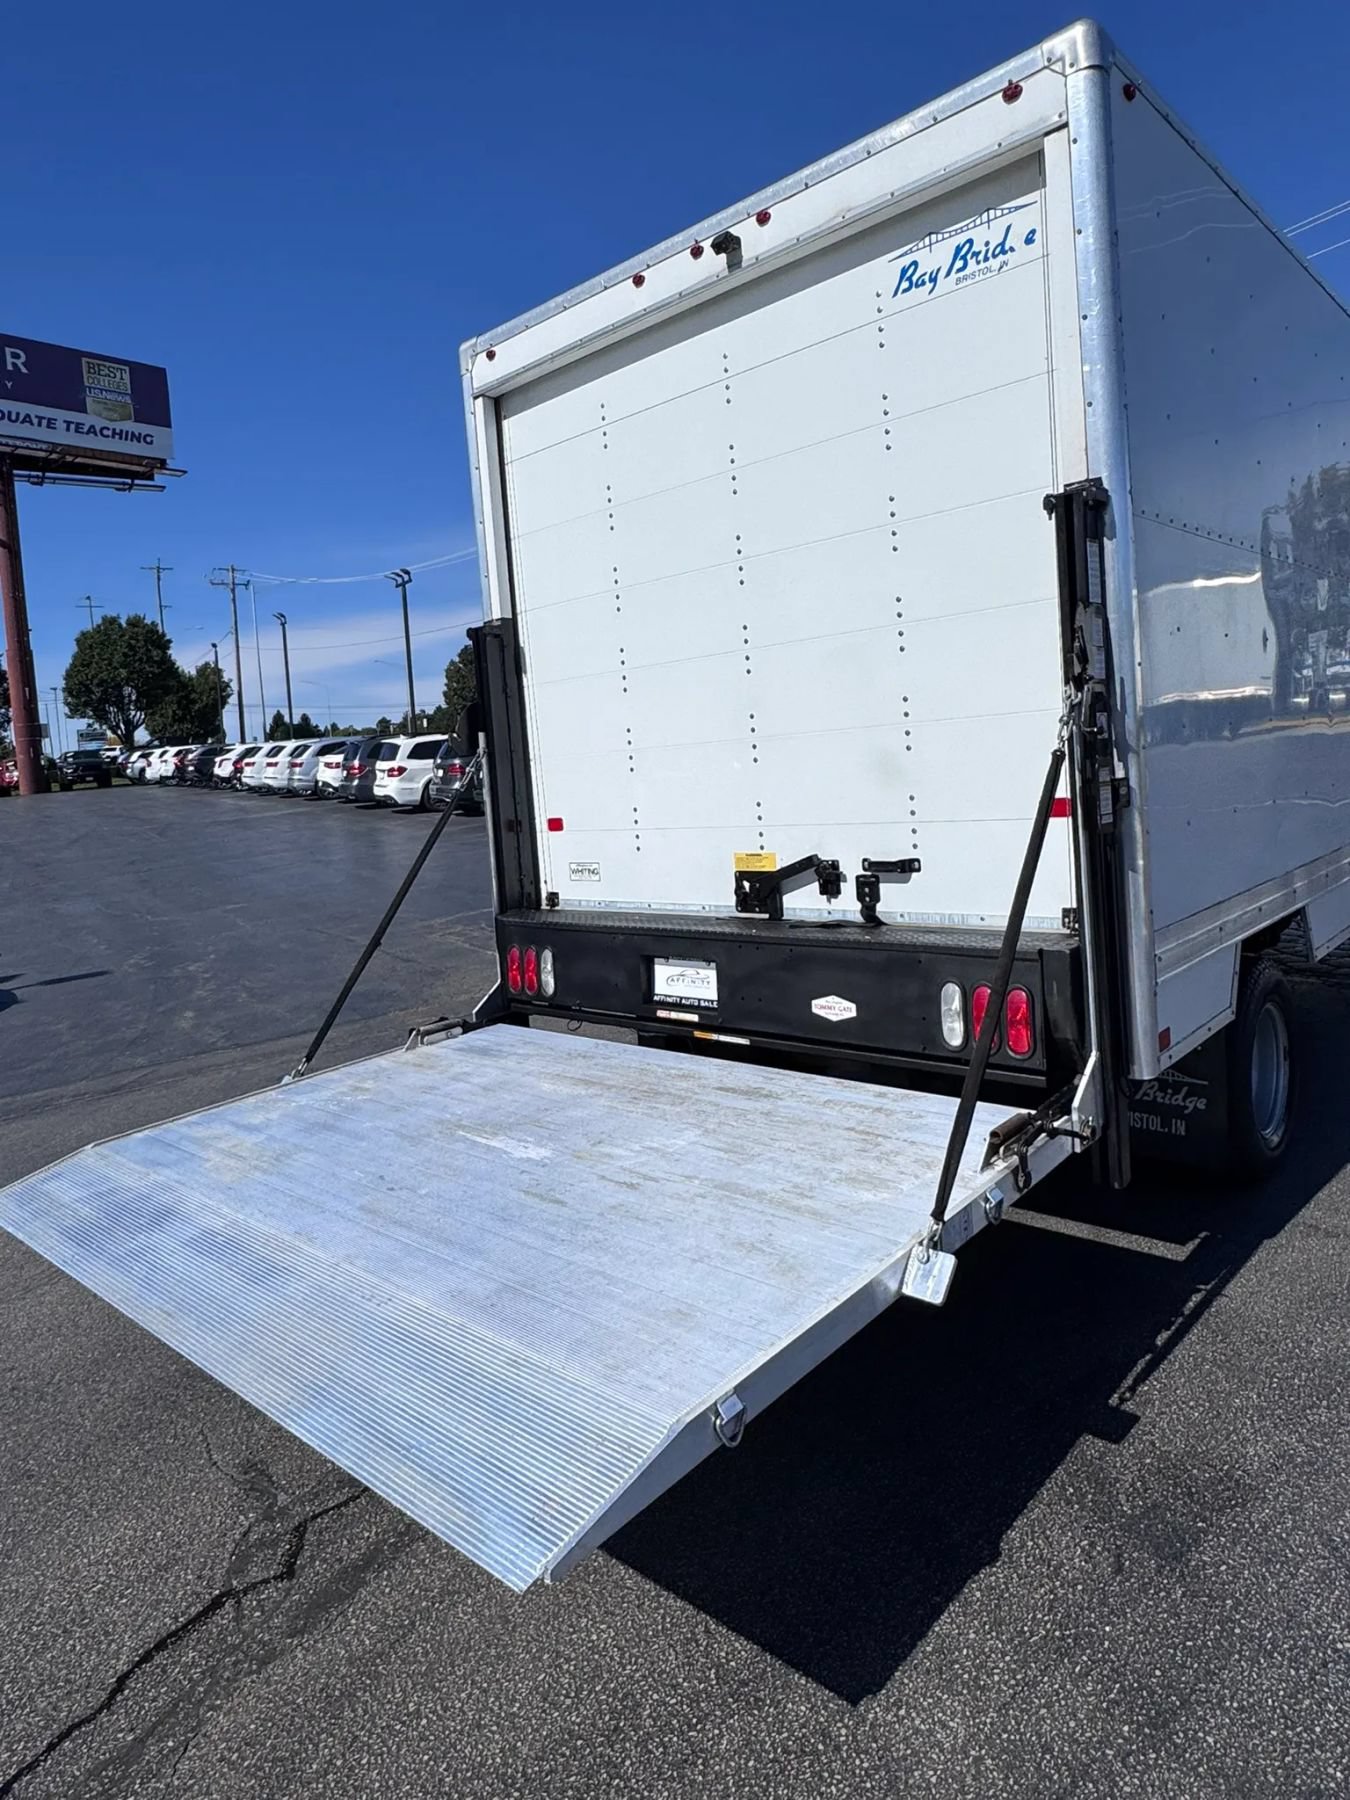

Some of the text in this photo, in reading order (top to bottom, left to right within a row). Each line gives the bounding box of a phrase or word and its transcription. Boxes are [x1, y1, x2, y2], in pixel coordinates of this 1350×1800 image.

[892, 223, 1037, 298] Bay Bride
[86, 360, 128, 381] BEST
[86, 375, 129, 392] COLLEGES
[63, 419, 155, 446] TEACHING
[653, 995, 680, 1004] AFFINITY
[682, 998, 699, 1006] AUTO
[1135, 1081, 1207, 1114] Bridge
[1128, 1111, 1186, 1136] ISTOL. IN
